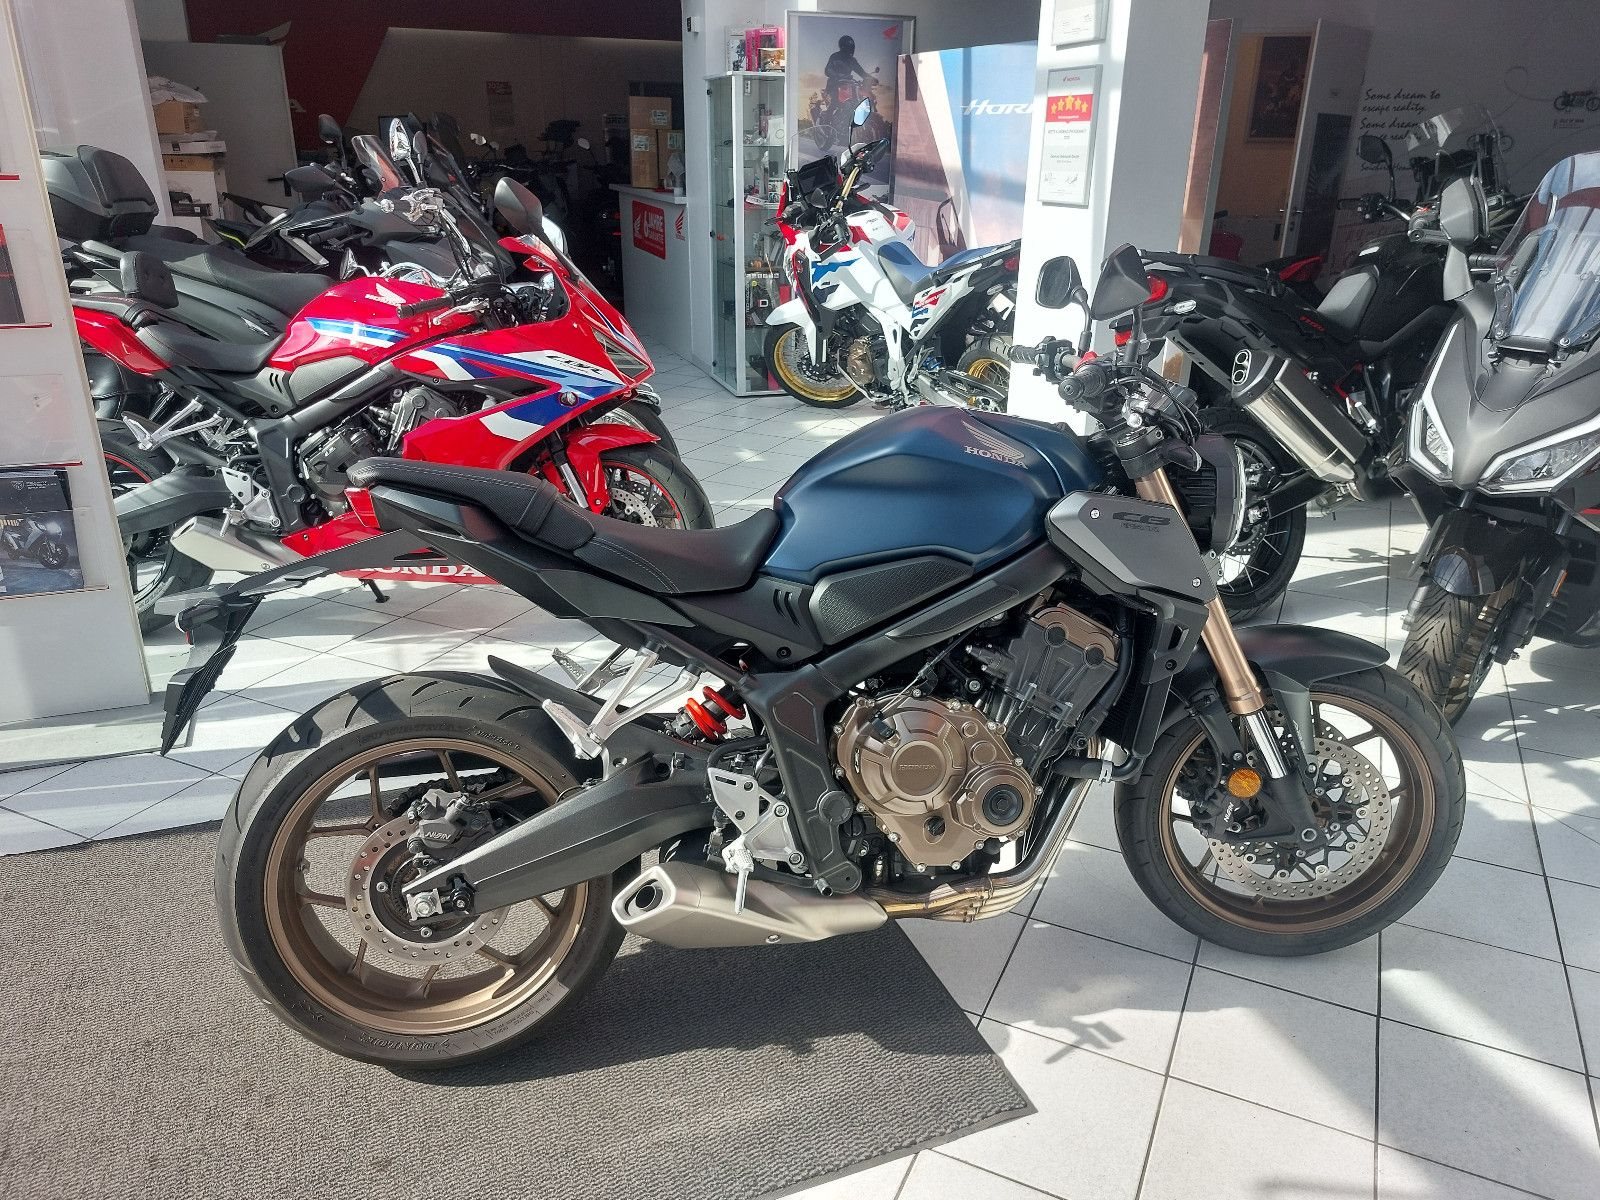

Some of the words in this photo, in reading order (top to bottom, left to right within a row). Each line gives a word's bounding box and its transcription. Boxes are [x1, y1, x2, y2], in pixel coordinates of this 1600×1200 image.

[1365, 88, 1391, 100] Some
[1394, 88, 1426, 99] dream
[1430, 89, 1440, 99] to
[1362, 105, 1390, 115] escape
[1360, 117, 1386, 129] Some
[963, 445, 1028, 469] HONDA
